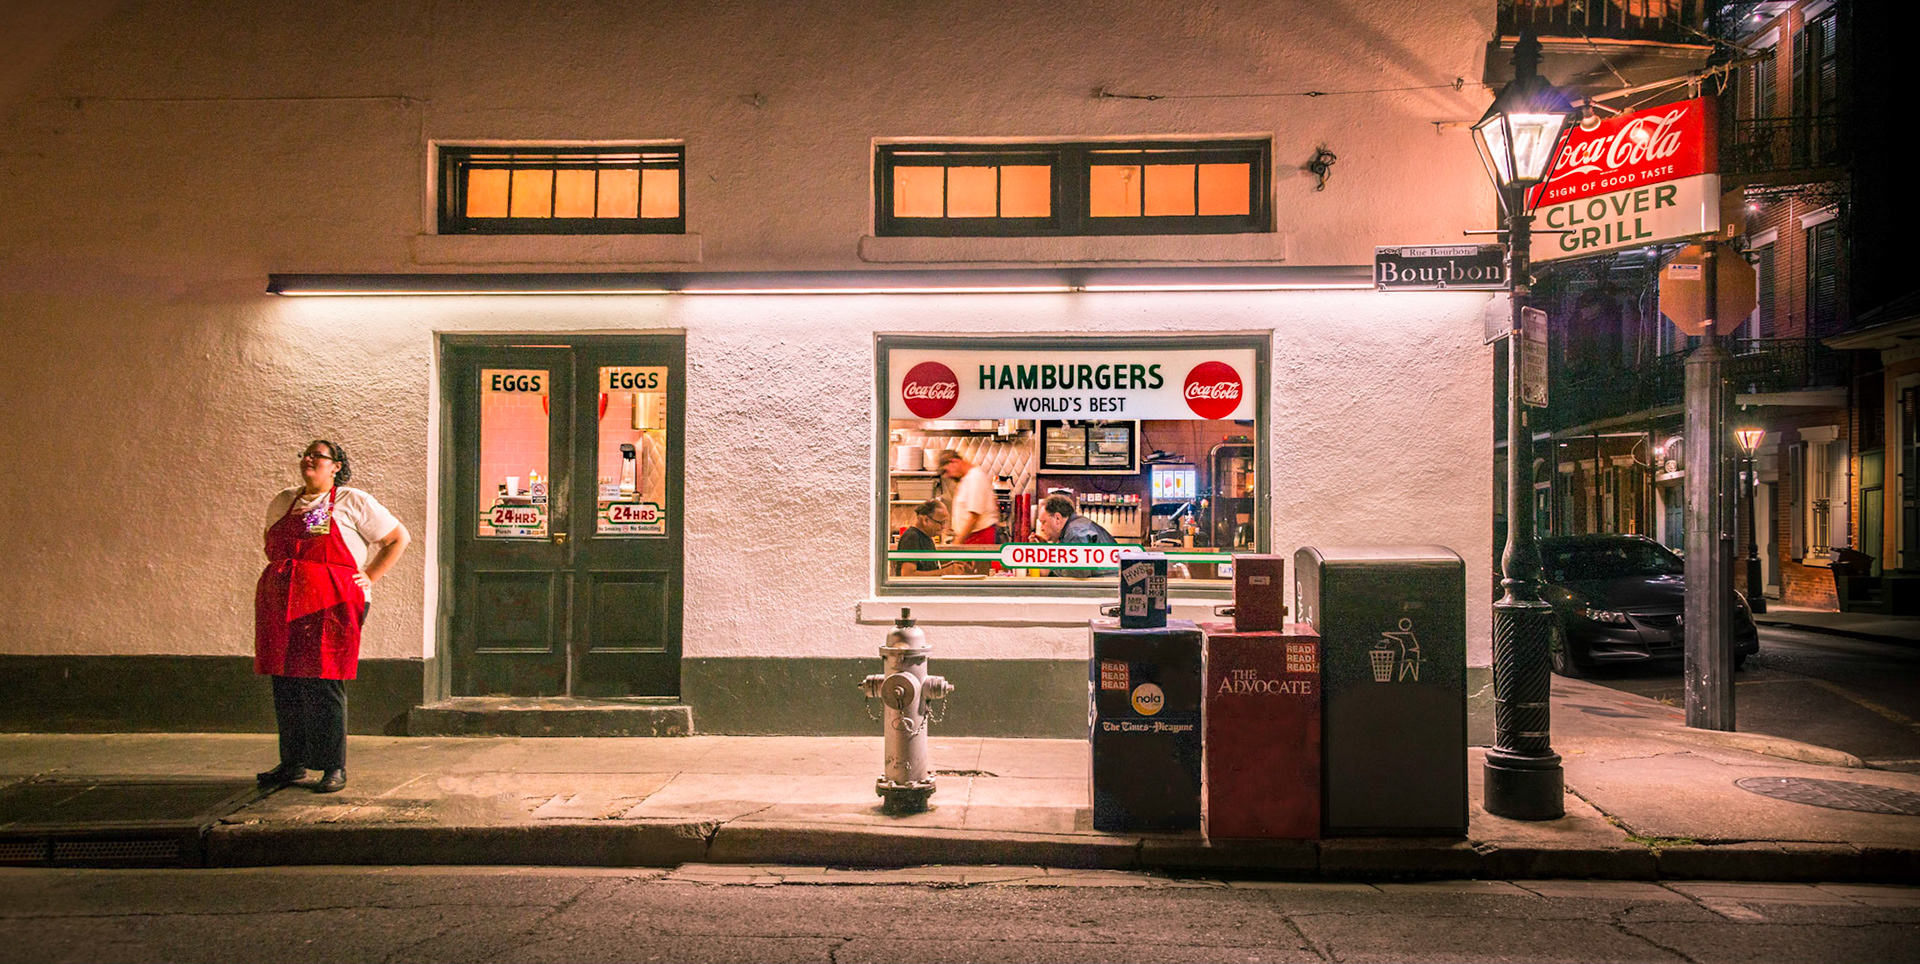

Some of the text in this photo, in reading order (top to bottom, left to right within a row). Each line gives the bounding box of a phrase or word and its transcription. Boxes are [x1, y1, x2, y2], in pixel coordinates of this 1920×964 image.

[1549, 165, 1674, 199] SIGN OF GOOD TASTE
[1546, 184, 1677, 229] CLOVER
[1559, 217, 1652, 252] GRILL
[1409, 246, 1471, 256] Rue Bourbon
[1379, 260, 1500, 282] Bourbon
[491, 374, 541, 391] EGGS
[609, 372, 658, 389] EGGS
[978, 364, 1164, 390] HAMBURGERS
[903, 381, 957, 400] Coca-Cola
[1185, 381, 1240, 400] Coca-Cola
[1013, 397, 1126, 412] WORLD'S BEST
[1012, 548, 1078, 563] ORDERS
[1083, 548, 1105, 563] TO
[1286, 645, 1316, 653] READ!
[1286, 654, 1316, 662] READ!
[1101, 663, 1129, 671] READ!
[1231, 669, 1257, 680] THE
[1286, 663, 1316, 671] READ!
[1101, 672, 1129, 680] READ!
[1101, 680, 1129, 689] READ!
[1217, 676, 1312, 694] ADVOCATE
[1136, 692, 1161, 704] nola
[1102, 721, 1193, 734] The Times-Picayune
